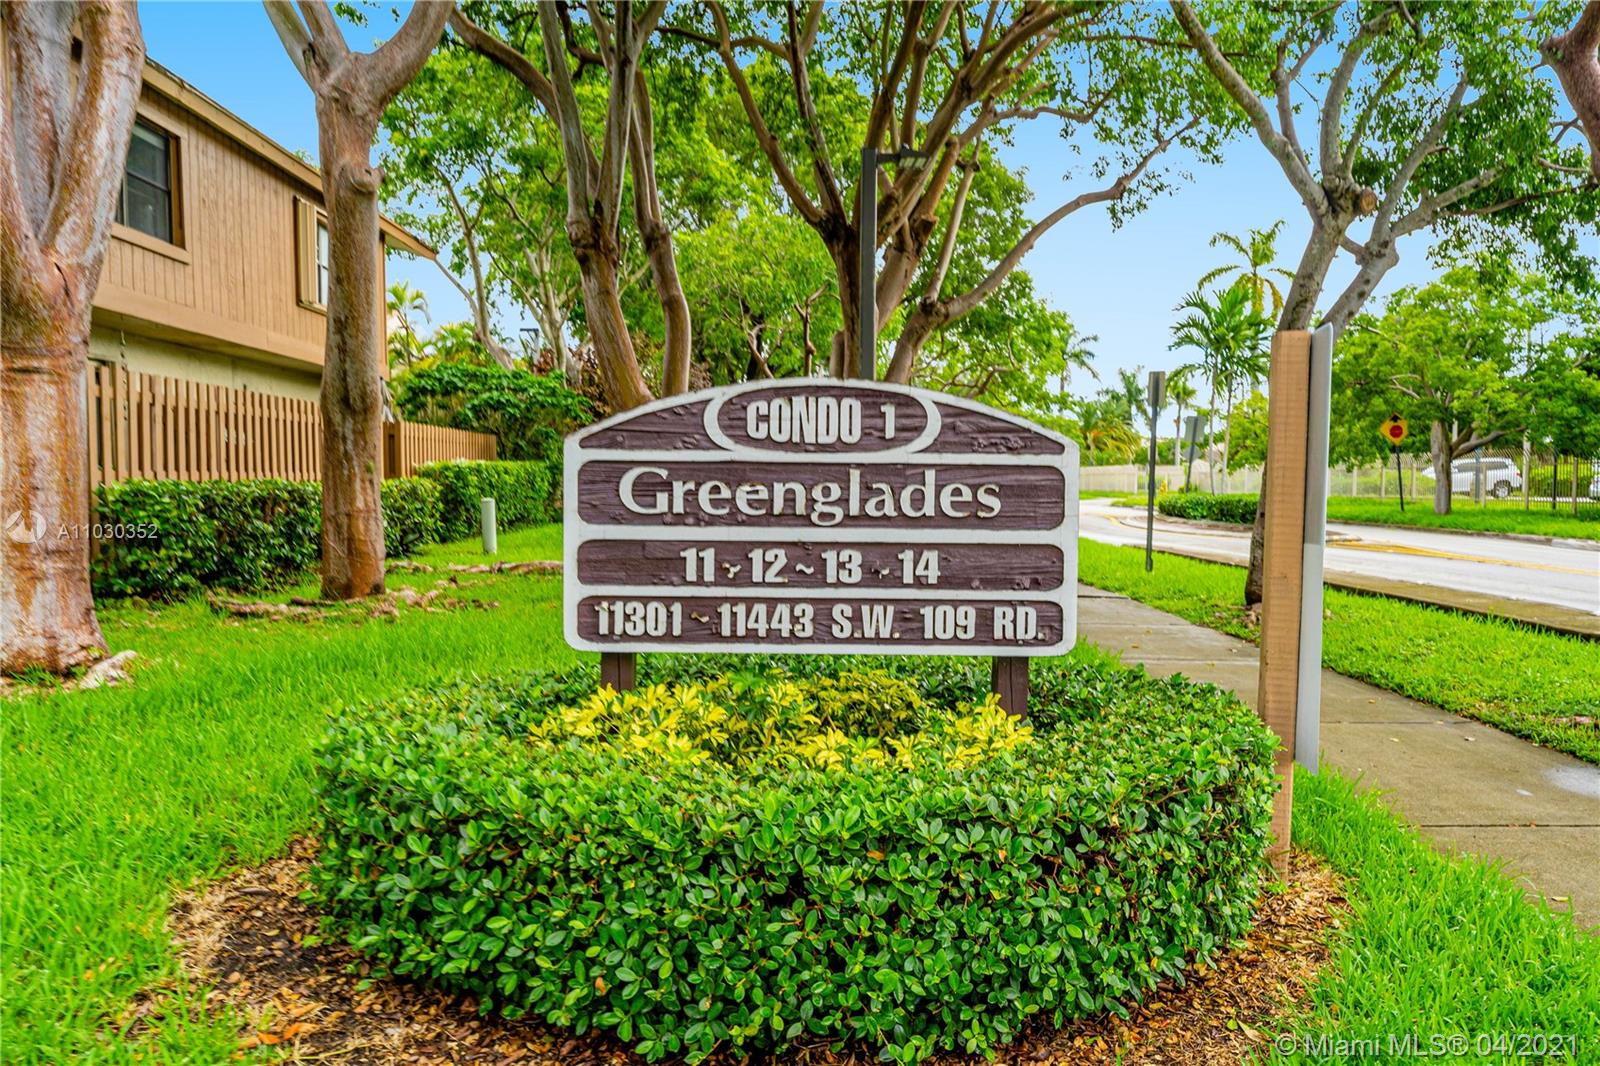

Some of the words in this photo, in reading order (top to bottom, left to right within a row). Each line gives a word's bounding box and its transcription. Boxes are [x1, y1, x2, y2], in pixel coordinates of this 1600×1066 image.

[746, 396, 861, 444] CONDO
[880, 404, 896, 440] 1
[618, 466, 1002, 527] Greenglades
[680, 547, 716, 583] 11
[747, 547, 788, 584] 12
[821, 549, 863, 584] 13
[897, 549, 941, 585] 14
[594, 601, 683, 638] 11301
[716, 602, 816, 639] 11443
[831, 604, 900, 640] S.W.
[919, 606, 977, 640] 109
[993, 606, 1045, 642] RD.
